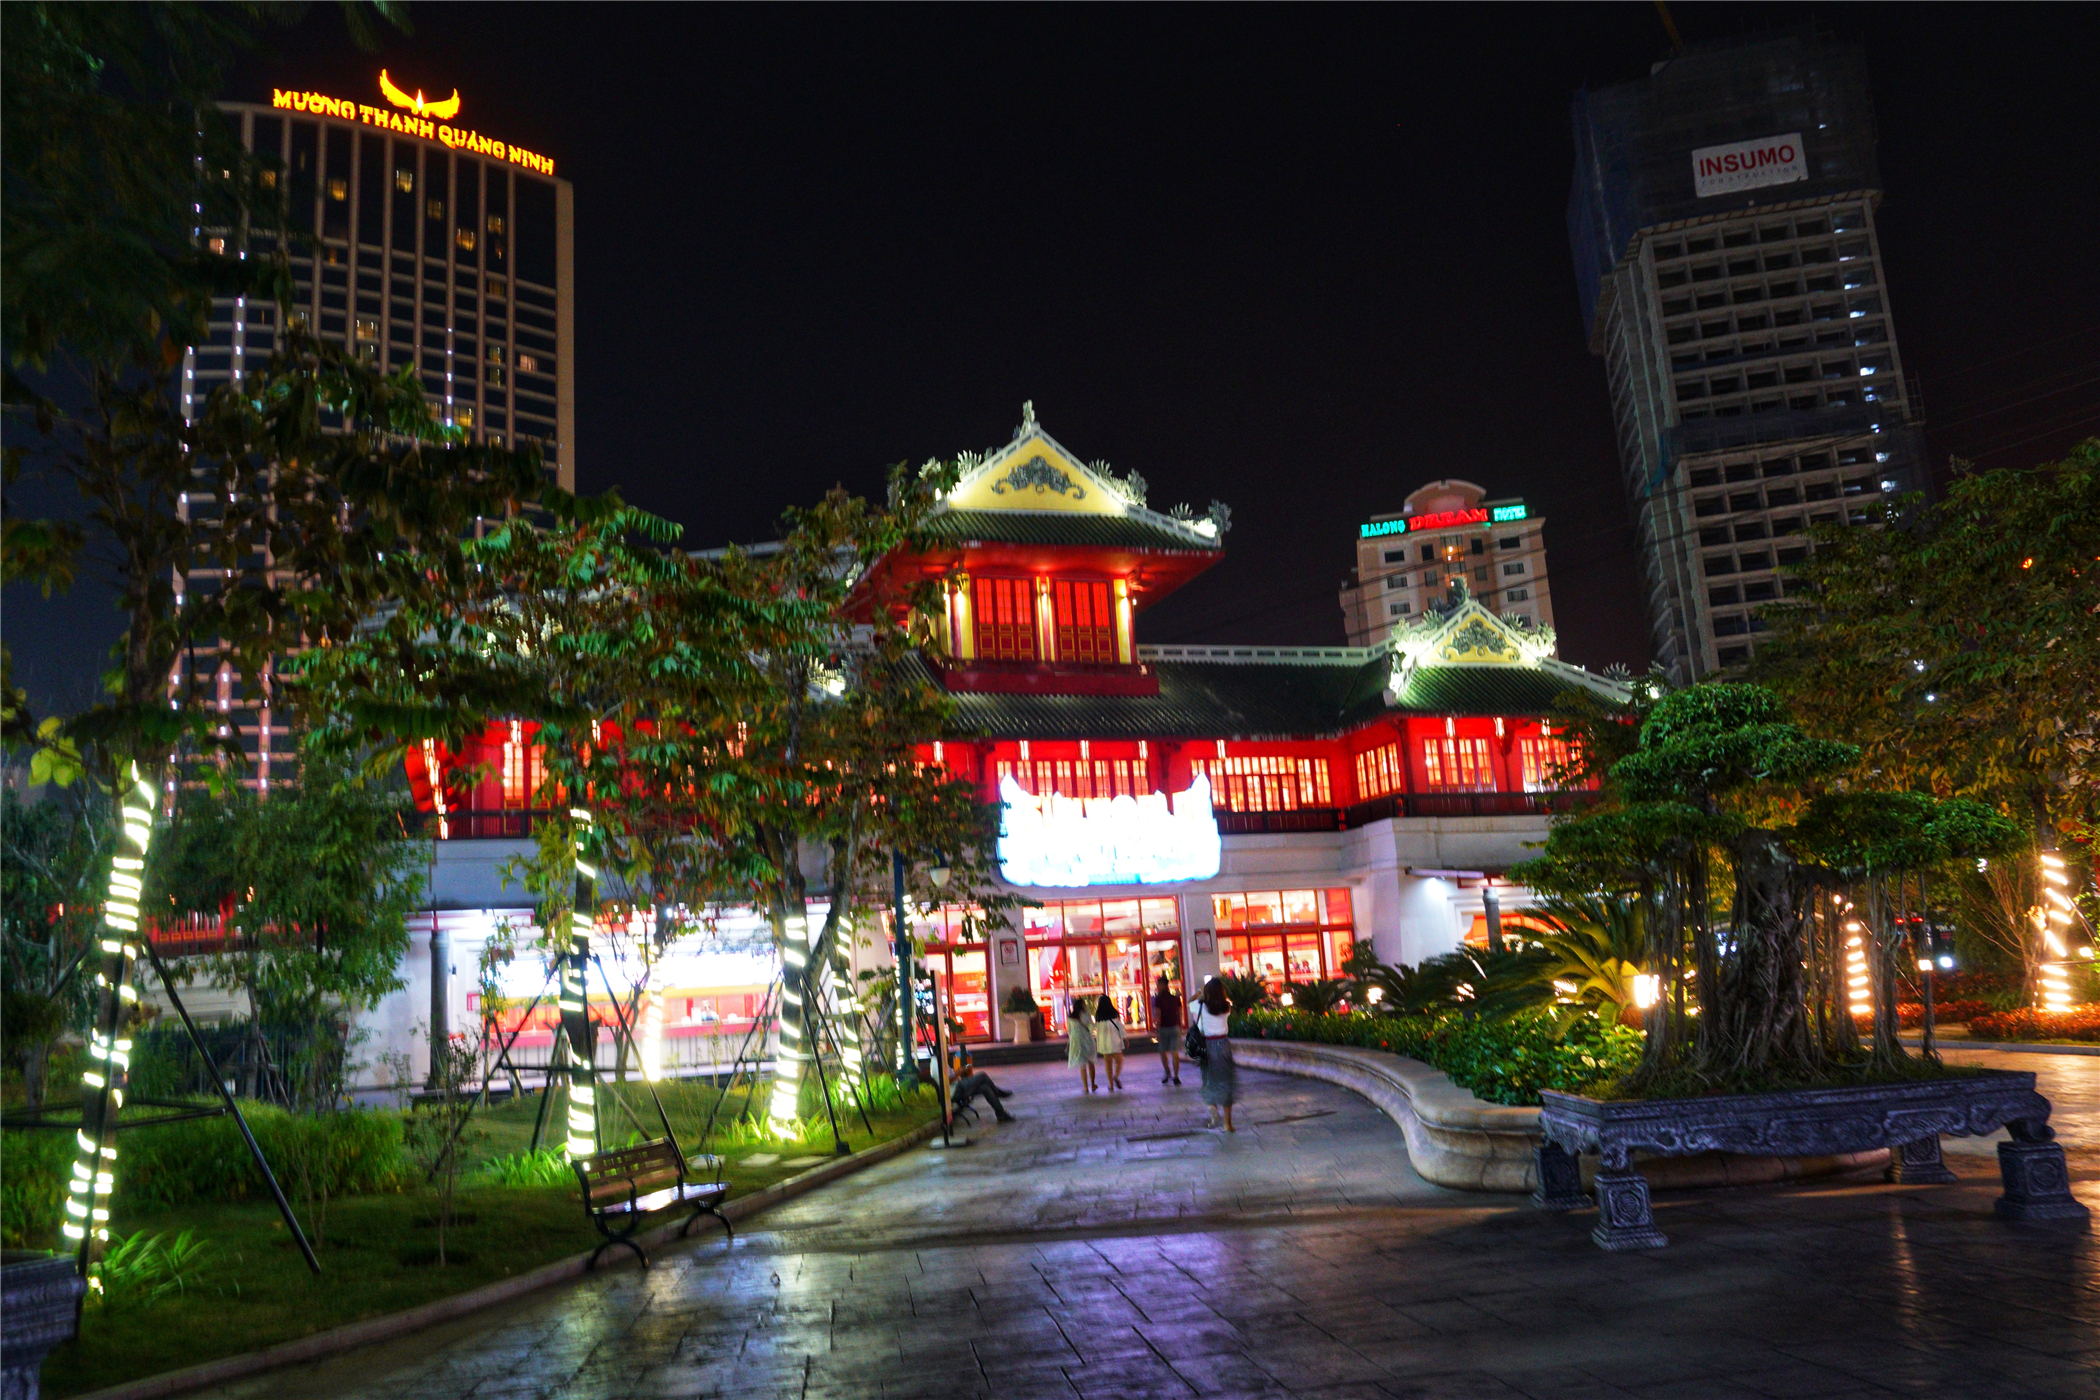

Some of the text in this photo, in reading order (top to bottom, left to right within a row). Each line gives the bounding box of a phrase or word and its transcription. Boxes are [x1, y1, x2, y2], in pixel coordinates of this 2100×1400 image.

[273, 88, 356, 120] MƯỜNG
[359, 104, 435, 139] THANH
[508, 144, 554, 176] NINH
[1699, 145, 1795, 177] INSUMO
[1361, 519, 1406, 538] HALONG
[1408, 508, 1489, 531] DREAM
